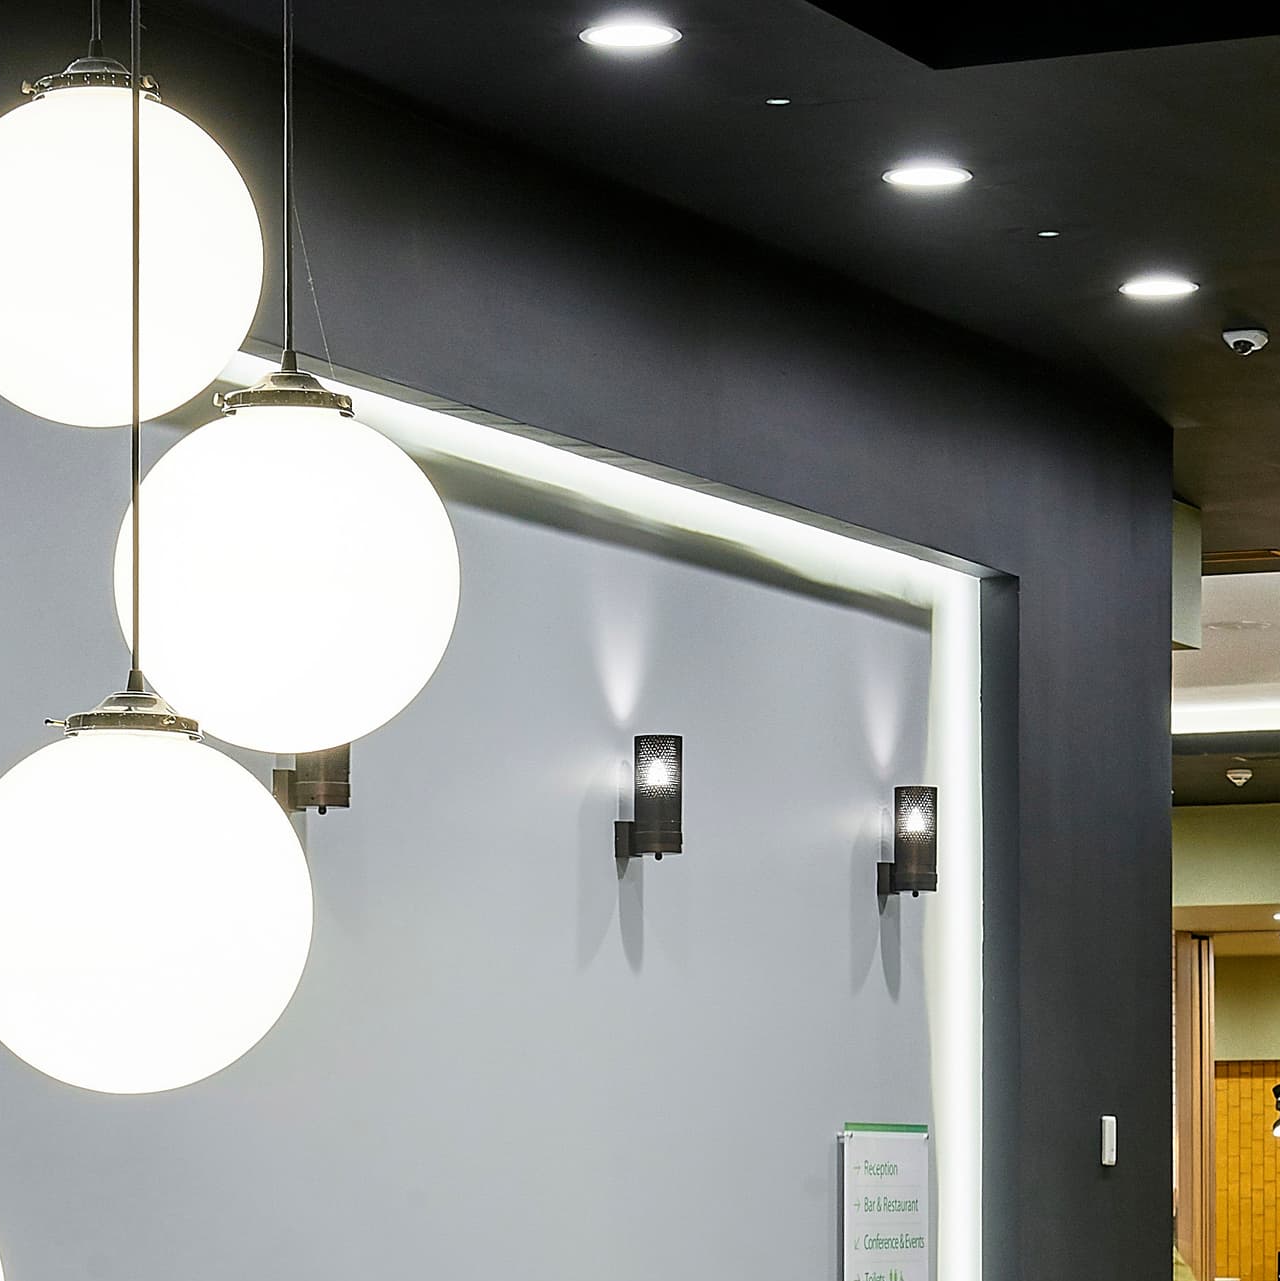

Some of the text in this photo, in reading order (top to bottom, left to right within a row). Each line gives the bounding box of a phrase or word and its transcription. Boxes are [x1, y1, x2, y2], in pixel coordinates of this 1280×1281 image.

[864, 1160, 898, 1180] Reception
[864, 1196, 919, 1212] Bar & Restaurant
[864, 1233, 899, 1250] Conference
[905, 1233, 924, 1249] Events
